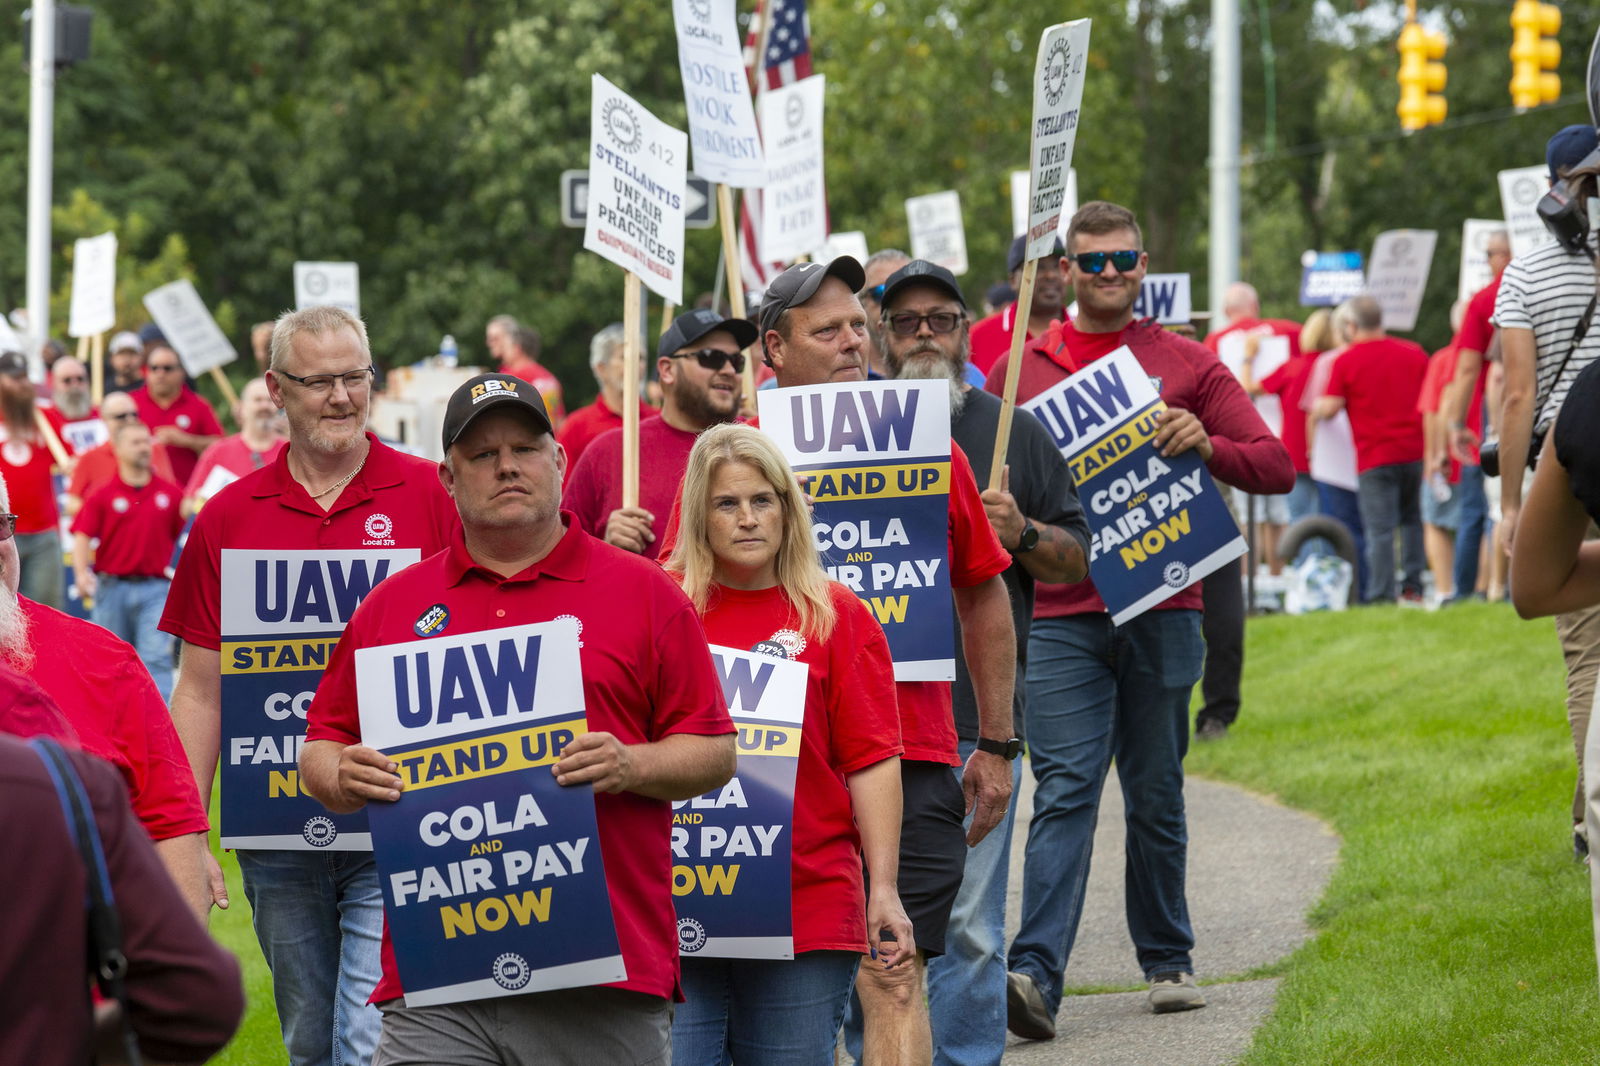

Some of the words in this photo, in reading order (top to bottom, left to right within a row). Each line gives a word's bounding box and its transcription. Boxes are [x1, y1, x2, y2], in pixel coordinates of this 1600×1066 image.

[613, 117, 632, 135] UAW
[1036, 109, 1078, 138] STELLANTIS
[648, 141, 675, 166] 412
[1040, 142, 1067, 167] UNFAIR
[595, 143, 681, 210] STELLANTIS
[1037, 166, 1062, 190] LABOR
[613, 176, 662, 224] UNFAIR
[1032, 187, 1065, 214] RACTICES
[616, 196, 658, 239] LABOR
[598, 203, 676, 266] PRACTICES
[1133, 282, 1177, 317] AW
[470, 380, 517, 399] RBV
[790, 388, 920, 453] UAW
[1033, 362, 1133, 449] UAW
[1071, 433, 1132, 481] TAND
[803, 471, 886, 498] TAND
[897, 468, 940, 492] UP
[1090, 455, 1172, 515] COLA
[1090, 506, 1152, 562] FAIR
[1148, 468, 1204, 520] PAY
[1127, 491, 1148, 511] AND
[362, 538, 382, 546] Local
[811, 518, 910, 552] COLA
[1119, 508, 1191, 570] NOW
[846, 551, 873, 563] AND
[871, 558, 942, 591] PAY
[255, 559, 390, 623] UAW
[416, 606, 441, 628] 97%
[232, 643, 337, 670] STAN
[757, 643, 783, 656] 97%
[778, 638, 795, 647] UAW
[393, 635, 542, 729] UAW
[264, 691, 316, 721] CO
[230, 735, 307, 765] FAI
[737, 728, 788, 752] UP
[396, 741, 508, 785] TAND
[520, 729, 575, 762] UP
[419, 793, 548, 847] COLA
[672, 813, 703, 825] AND
[469, 839, 503, 856] AND
[700, 824, 784, 858] PAY
[390, 857, 496, 907] FAIR
[502, 837, 590, 886] PAY
[671, 864, 741, 897] OW
[440, 887, 553, 940] NOW
[681, 930, 696, 938] UAW
[503, 965, 519, 976] UAW
